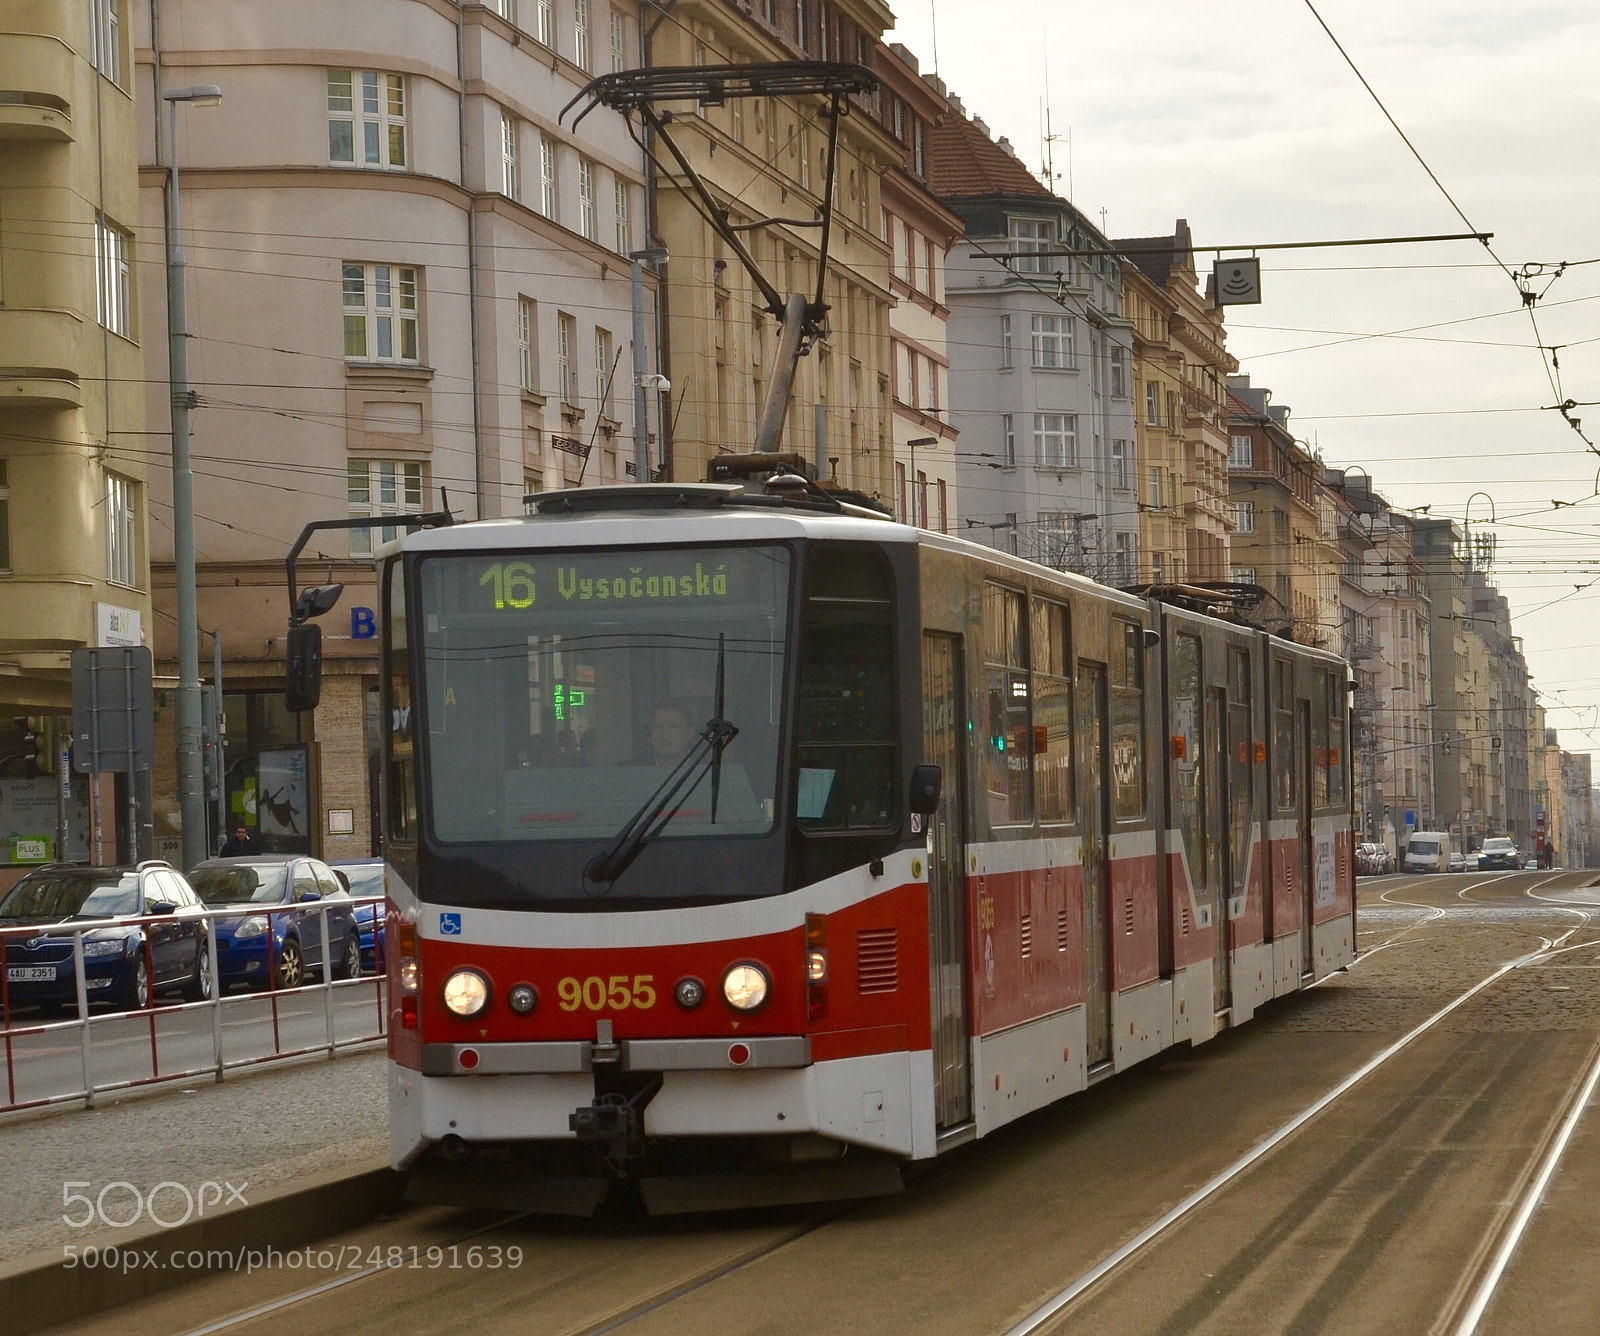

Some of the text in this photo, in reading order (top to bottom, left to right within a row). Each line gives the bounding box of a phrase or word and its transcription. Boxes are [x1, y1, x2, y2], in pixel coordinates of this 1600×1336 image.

[480, 562, 727, 609] 16 Vysočanská
[351, 606, 376, 639] B
[18, 844, 41, 854] PLUS
[9, 967, 52, 978] 4AU 2351
[557, 974, 657, 1012] 9055
